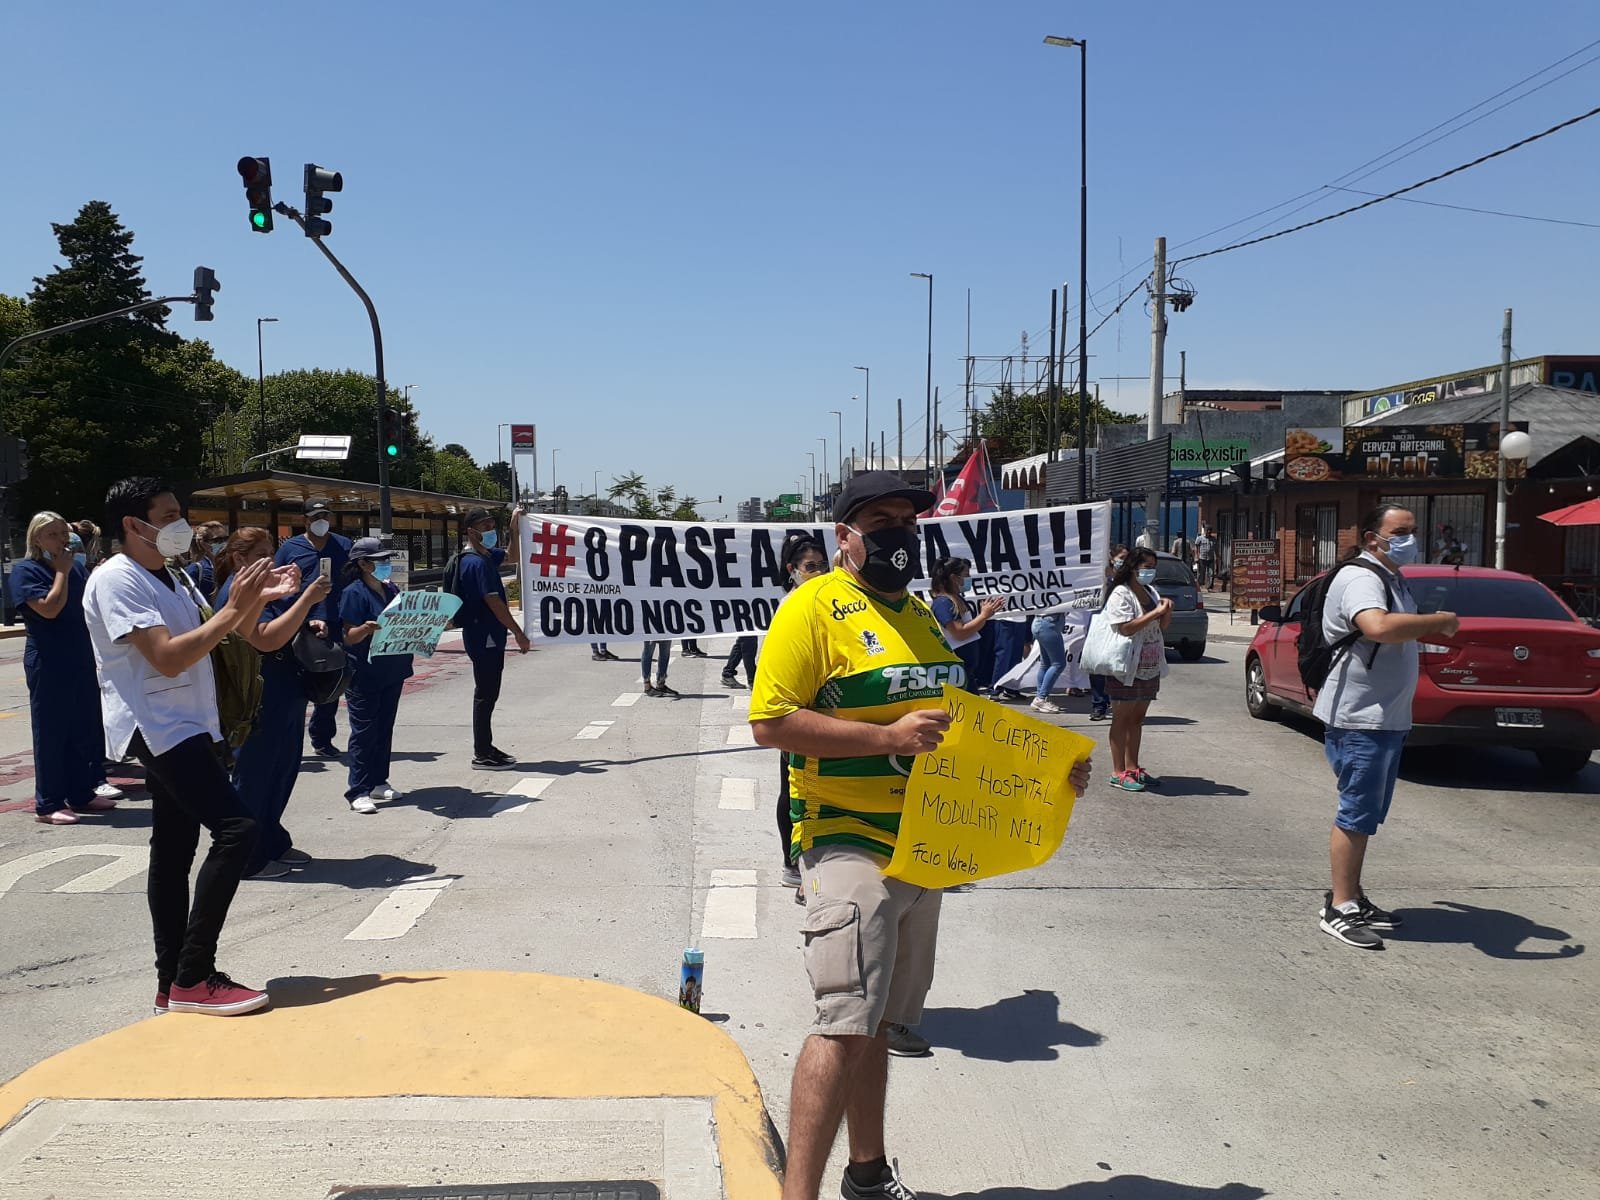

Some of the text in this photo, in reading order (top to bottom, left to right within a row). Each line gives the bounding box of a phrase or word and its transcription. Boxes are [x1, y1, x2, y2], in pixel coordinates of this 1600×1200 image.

[1202, 445, 1247, 461] existir
[1362, 440, 1446, 452] CERVEZA ARTESANAL
[619, 524, 741, 589] PASE
[751, 528, 783, 588] A
[532, 580, 621, 595] LOMAS DE ZAMORA
[963, 570, 1073, 597] ERSONAL
[830, 598, 867, 621] Secco
[1001, 592, 1062, 612] ALUD
[540, 595, 780, 638] COMO NOS PRO
[867, 647, 885, 656] LYON
[948, 696, 1049, 765] NO AL CIERRE
[923, 752, 961, 781] DEL
[922, 791, 999, 838] MODULAR
